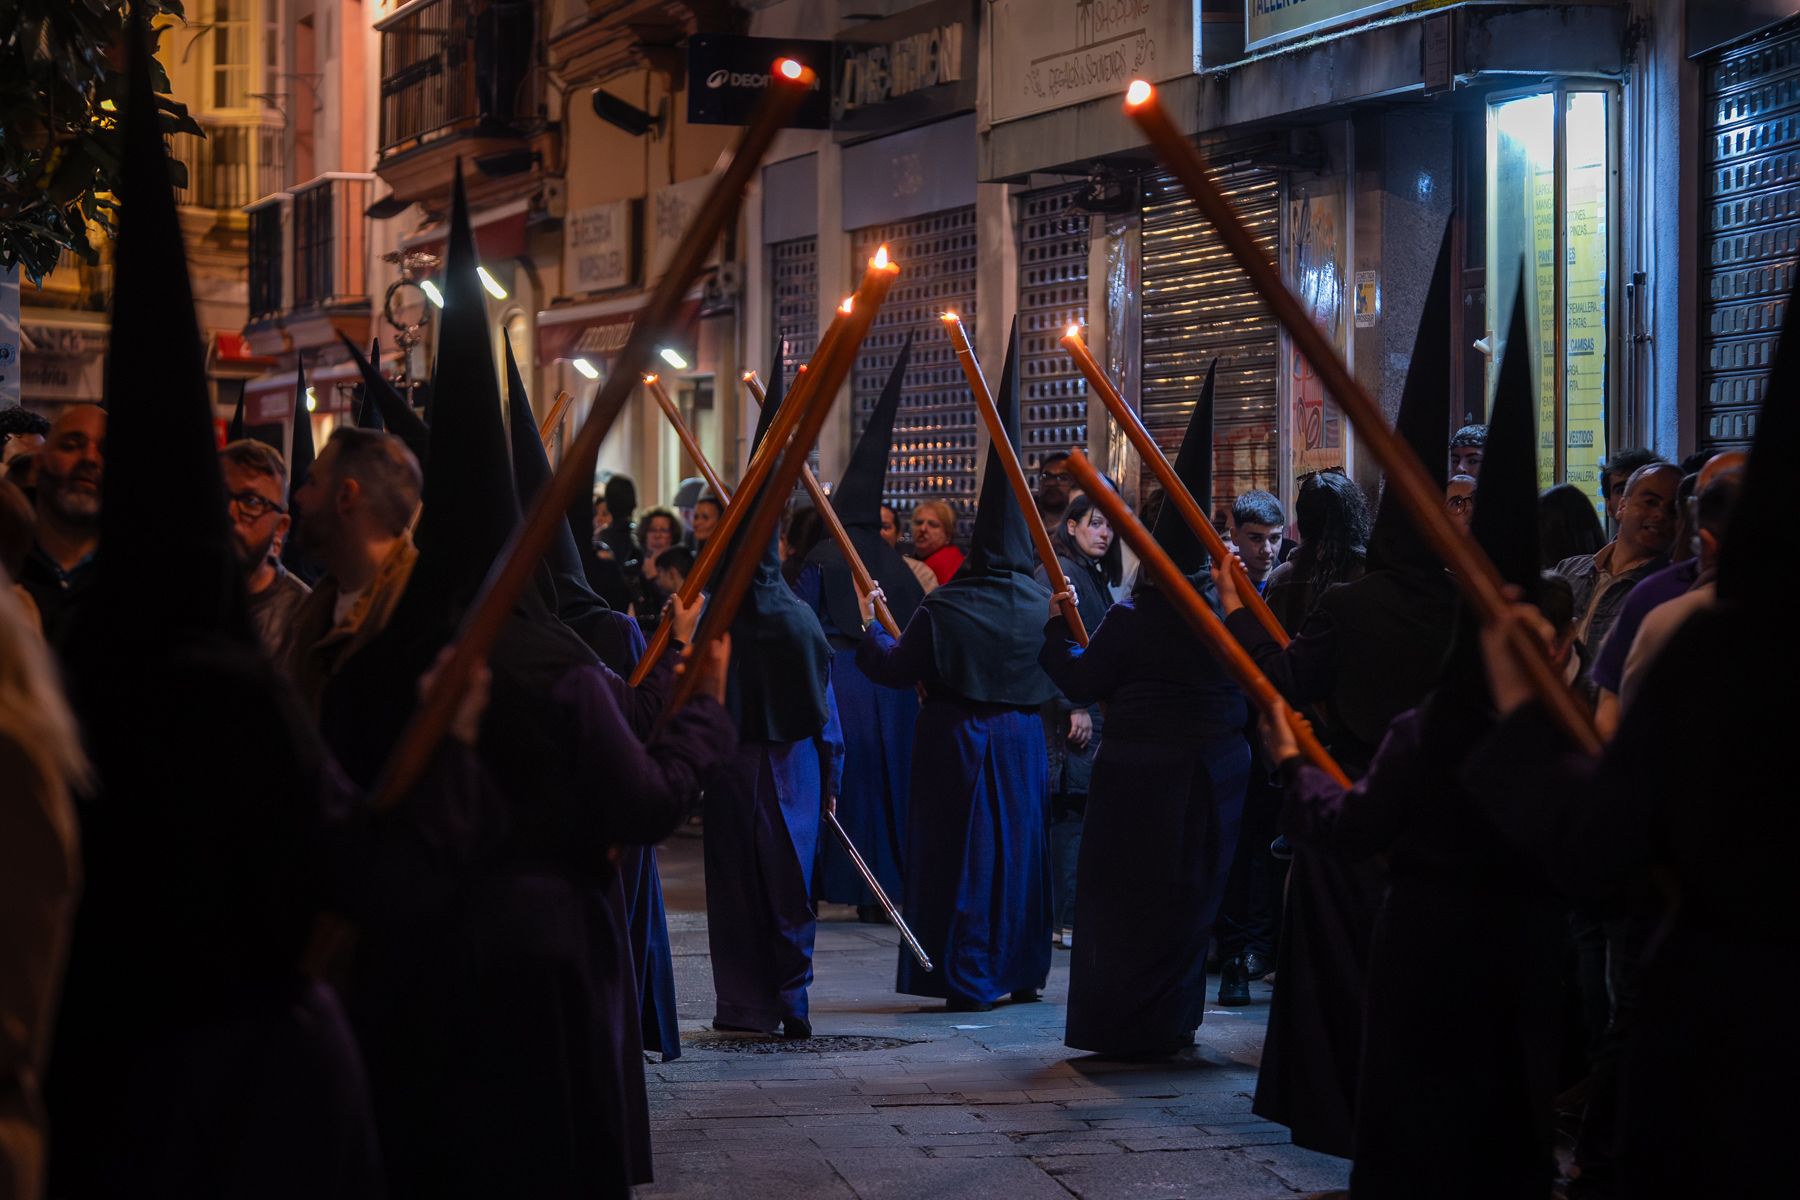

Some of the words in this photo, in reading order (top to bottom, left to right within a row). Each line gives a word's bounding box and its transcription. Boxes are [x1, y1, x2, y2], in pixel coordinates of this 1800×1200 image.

[1571, 338, 1595, 352] CAMISAS
[1568, 430, 1594, 444] VESTIDOS
[1568, 470, 1595, 482] REMALLERA
